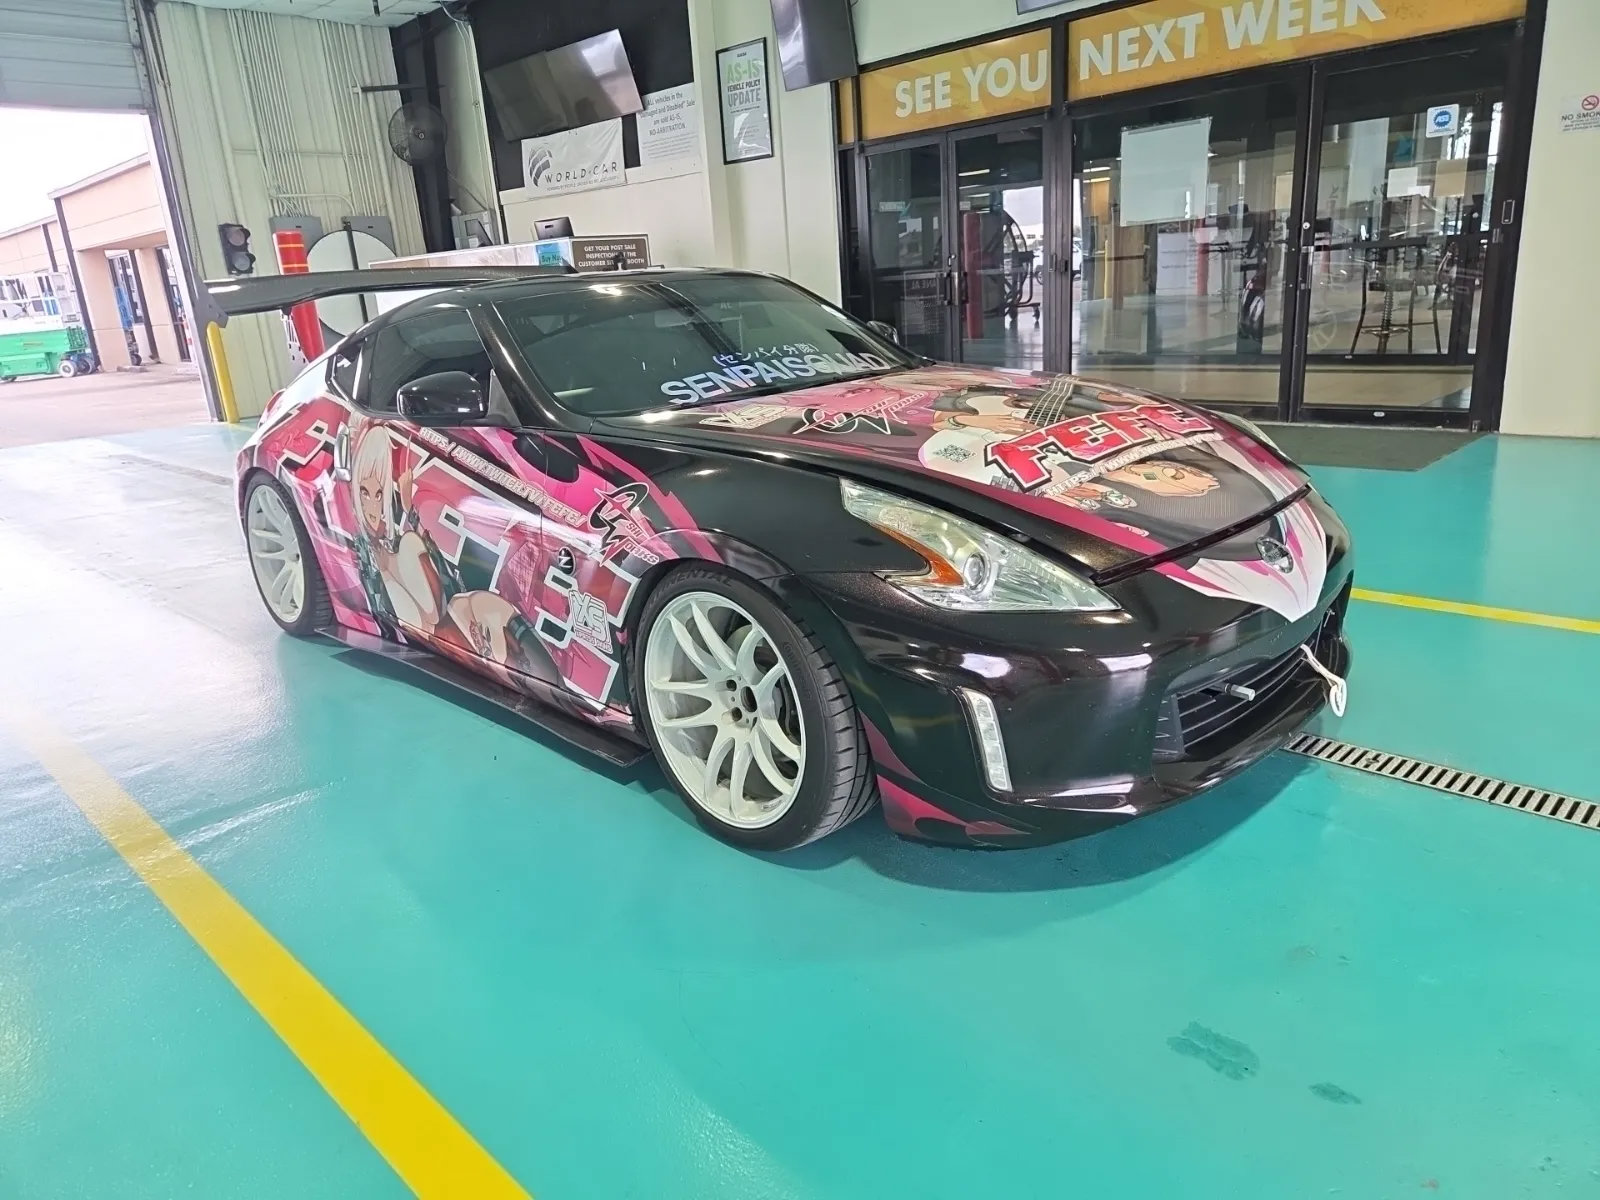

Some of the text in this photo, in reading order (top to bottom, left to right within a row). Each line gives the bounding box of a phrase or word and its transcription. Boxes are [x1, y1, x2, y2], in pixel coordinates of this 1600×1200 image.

[1079, 11, 1205, 80] NEXT
[727, 59, 762, 83] AS-IS
[727, 79, 761, 92] VEHICLE POLICY
[895, 49, 1048, 118] SEE YOU
[727, 88, 762, 107] UPDATE
[545, 161, 618, 183] WORLD CAR
[660, 352, 892, 404] SENPAISQUAD
